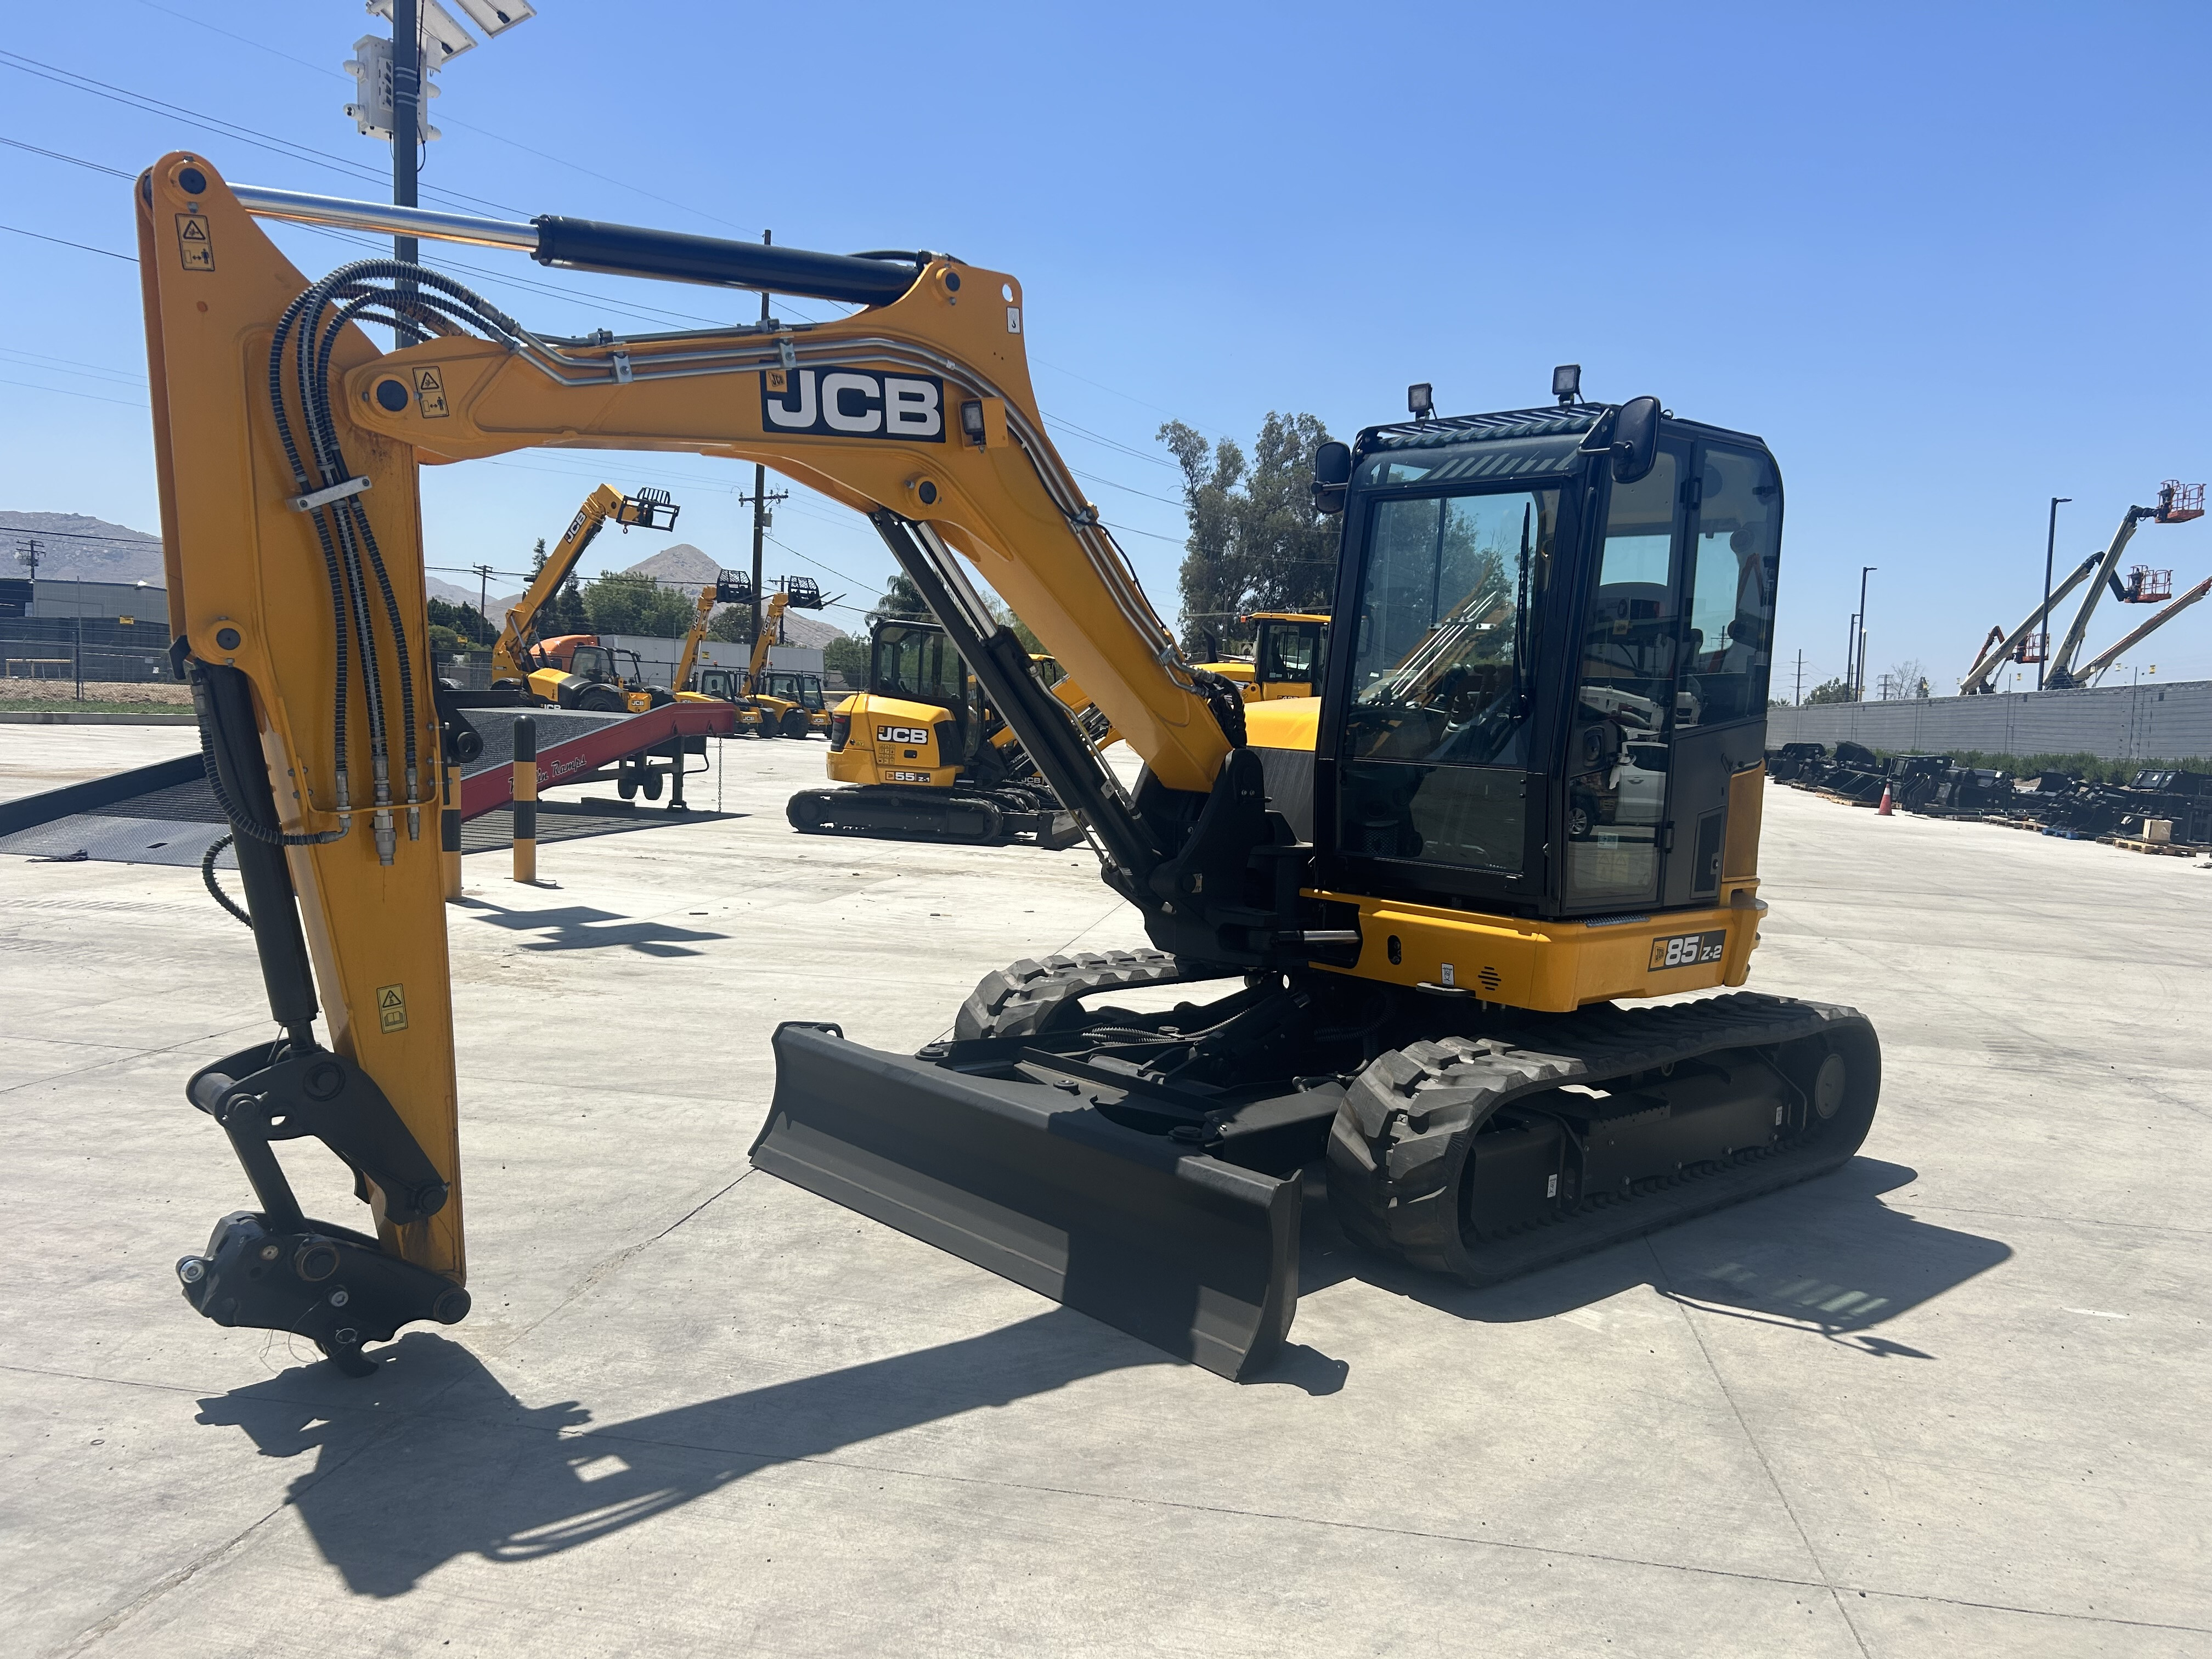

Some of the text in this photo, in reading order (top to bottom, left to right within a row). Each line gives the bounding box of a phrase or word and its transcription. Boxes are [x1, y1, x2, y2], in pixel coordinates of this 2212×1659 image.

[768, 370, 941, 436] JCB
[567, 512, 586, 543] JCB
[693, 610, 702, 630] JCB
[763, 616, 772, 636] JCB
[878, 727, 927, 744] JCB
[551, 754, 587, 778] Ramps
[895, 772, 915, 781] 55
[1665, 935, 1700, 966] 85
